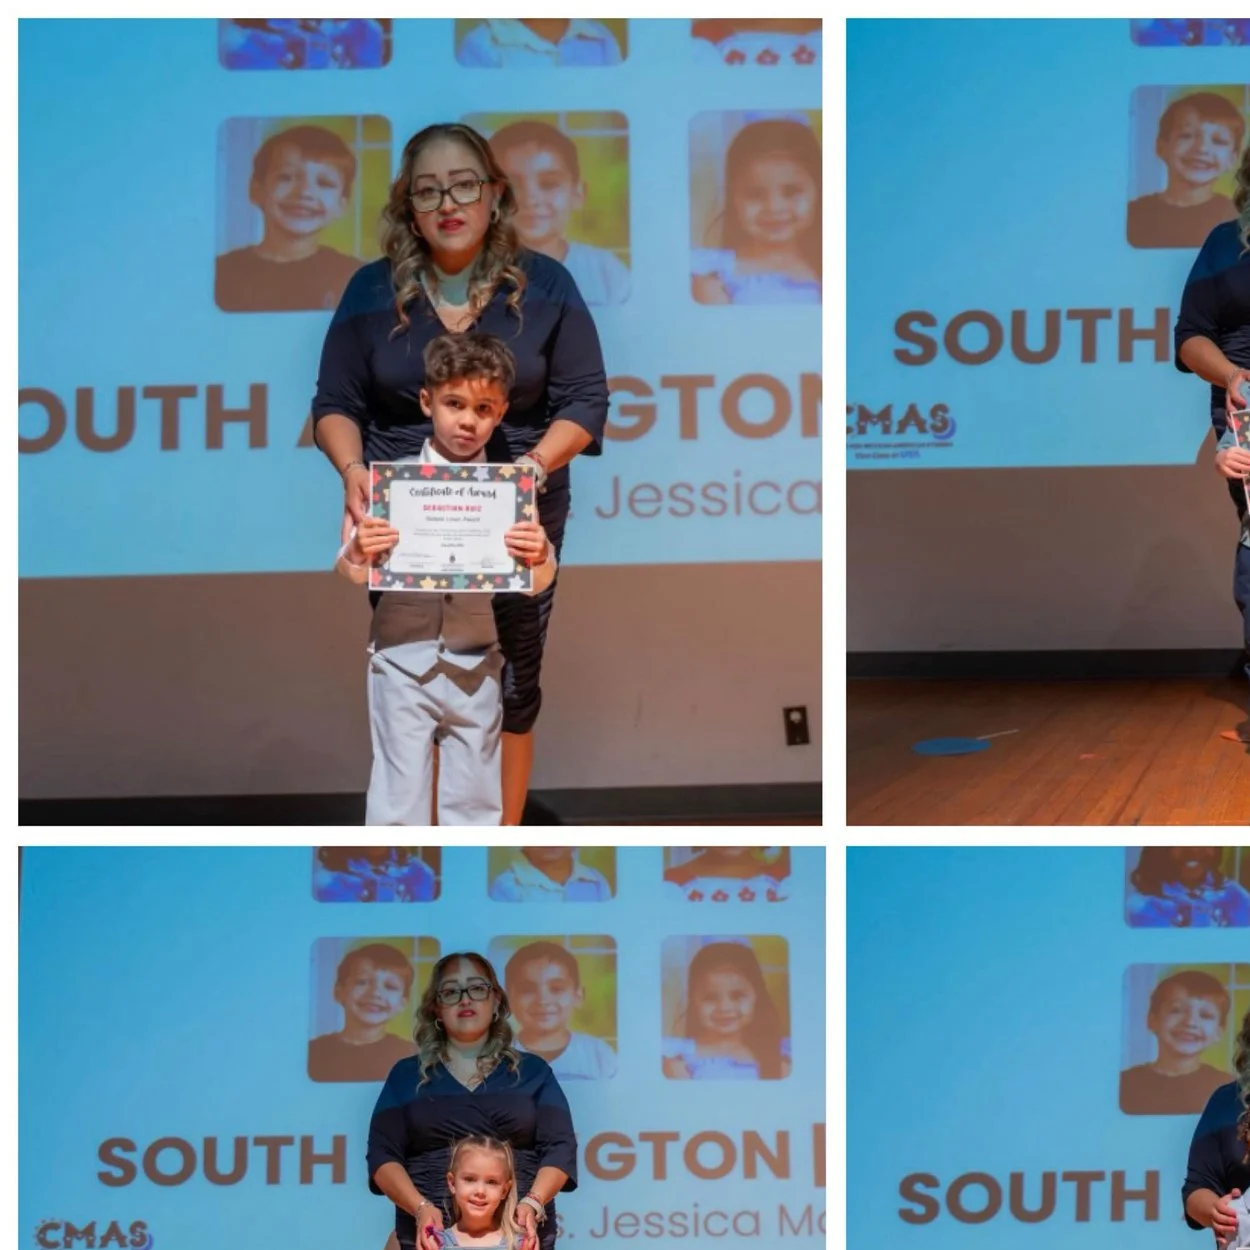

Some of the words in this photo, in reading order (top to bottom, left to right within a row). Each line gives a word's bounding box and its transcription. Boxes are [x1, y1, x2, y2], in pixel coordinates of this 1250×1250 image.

[893, 307, 1170, 366] SOUTH
[595, 470, 822, 519] Jessica
[97, 1135, 347, 1187] SOUTH
[590, 1202, 760, 1240] Jessica
[898, 1170, 1160, 1225] SOUTH
